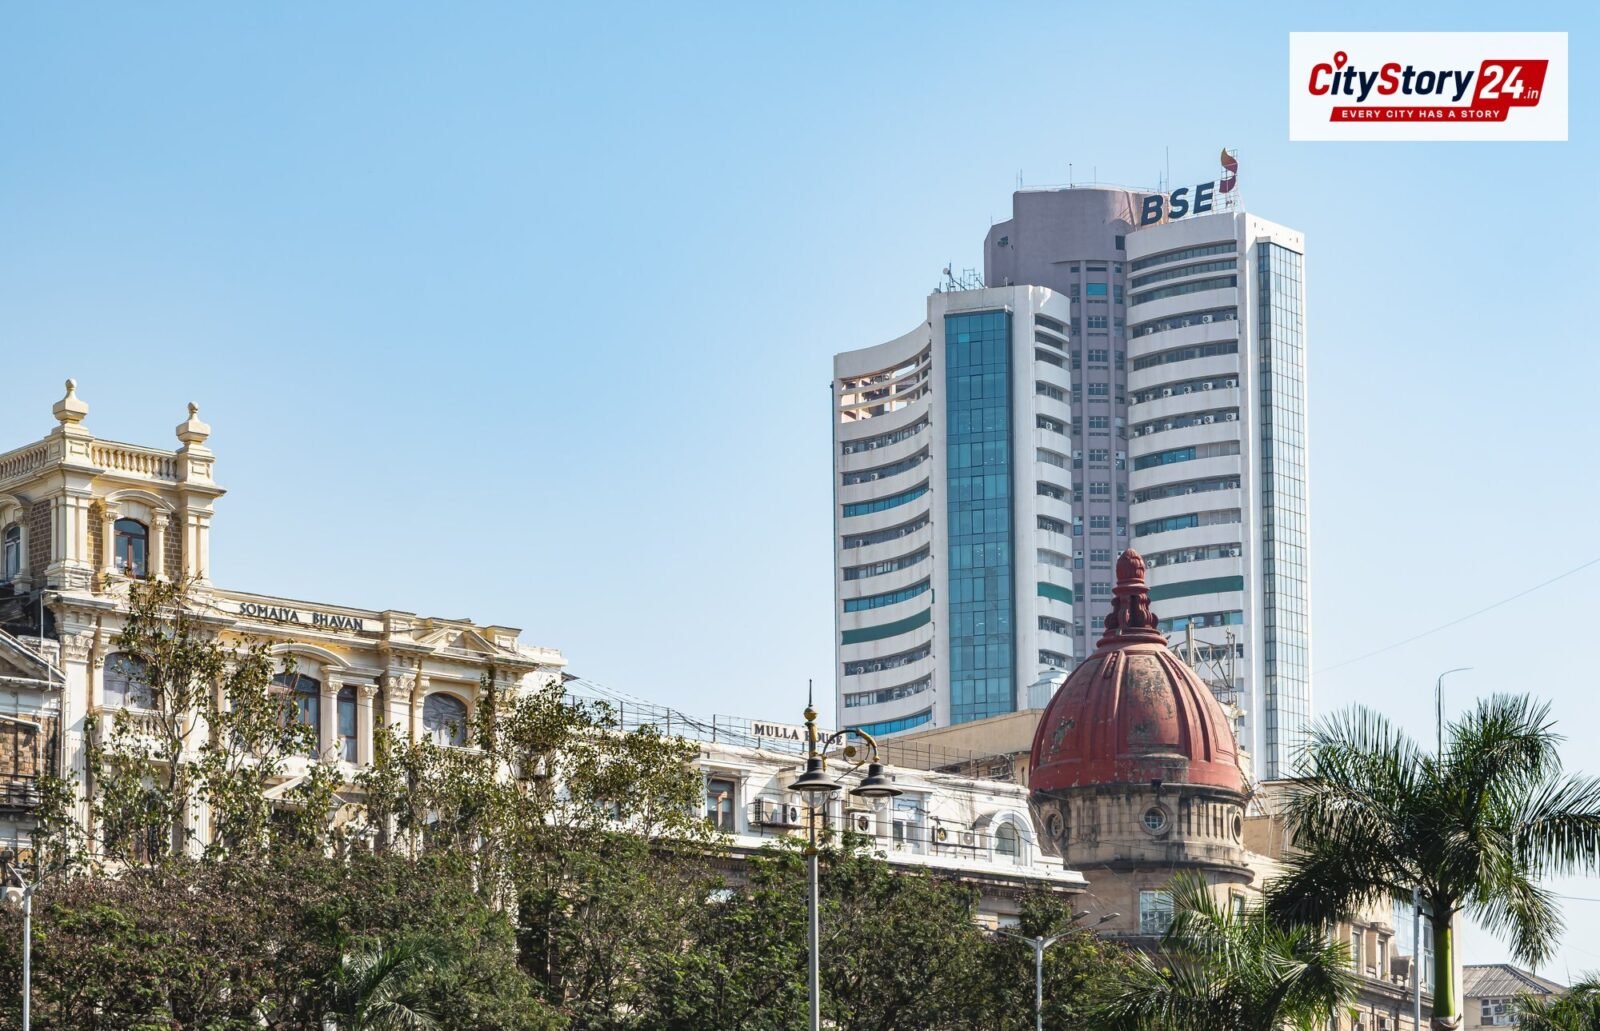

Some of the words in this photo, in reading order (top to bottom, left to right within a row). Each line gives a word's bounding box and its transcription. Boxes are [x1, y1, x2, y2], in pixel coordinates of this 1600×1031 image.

[1141, 182, 1214, 226] BSE
[240, 602, 299, 622] SOMAIYA
[312, 612, 363, 631] BHAVAN
[754, 723, 799, 740] MULLA
